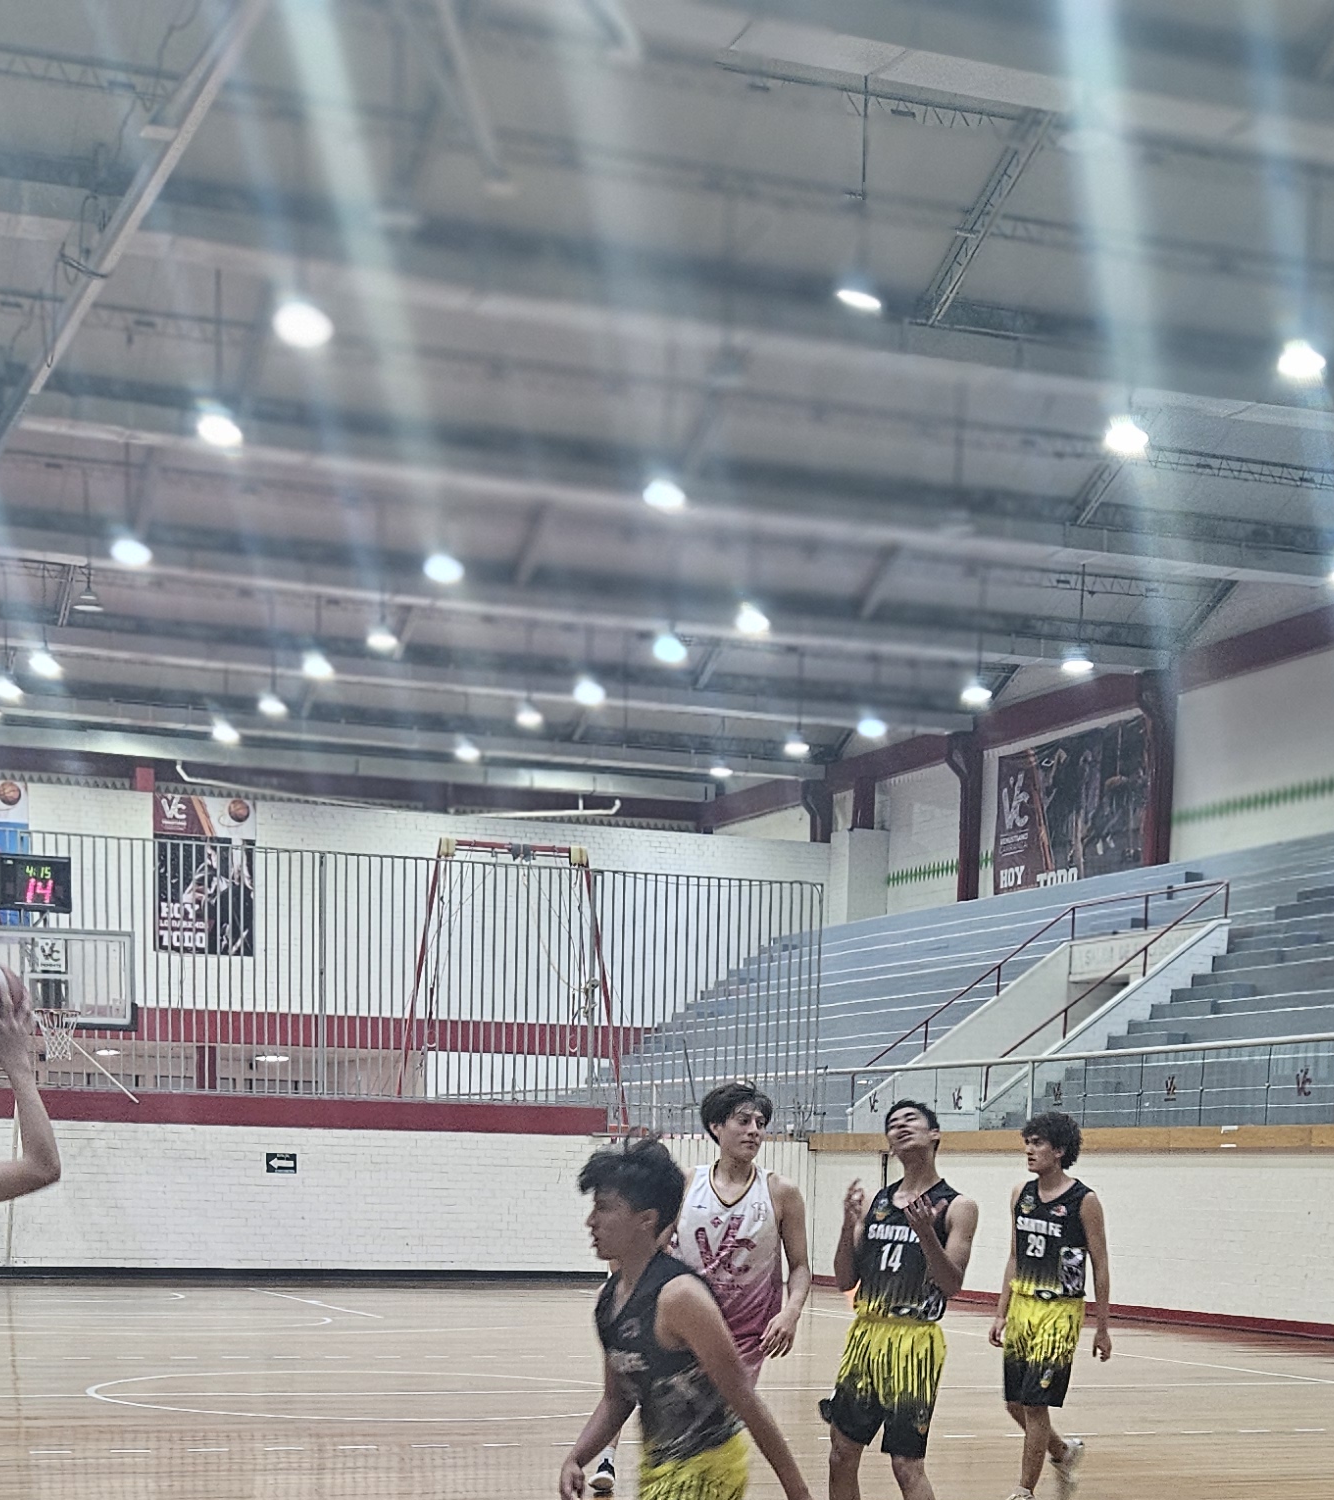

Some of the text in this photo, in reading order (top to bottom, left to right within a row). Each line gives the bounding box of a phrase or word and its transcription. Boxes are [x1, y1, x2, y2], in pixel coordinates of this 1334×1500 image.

[26, 865, 52, 879] 4:15
[1000, 865, 1025, 889] HOY
[25, 878, 54, 904] 14
[160, 902, 200, 919] HOY
[159, 930, 207, 948] TODO
[867, 1223, 910, 1242] SANTA
[1026, 1233, 1046, 1258] 29
[880, 1243, 904, 1272] 14
